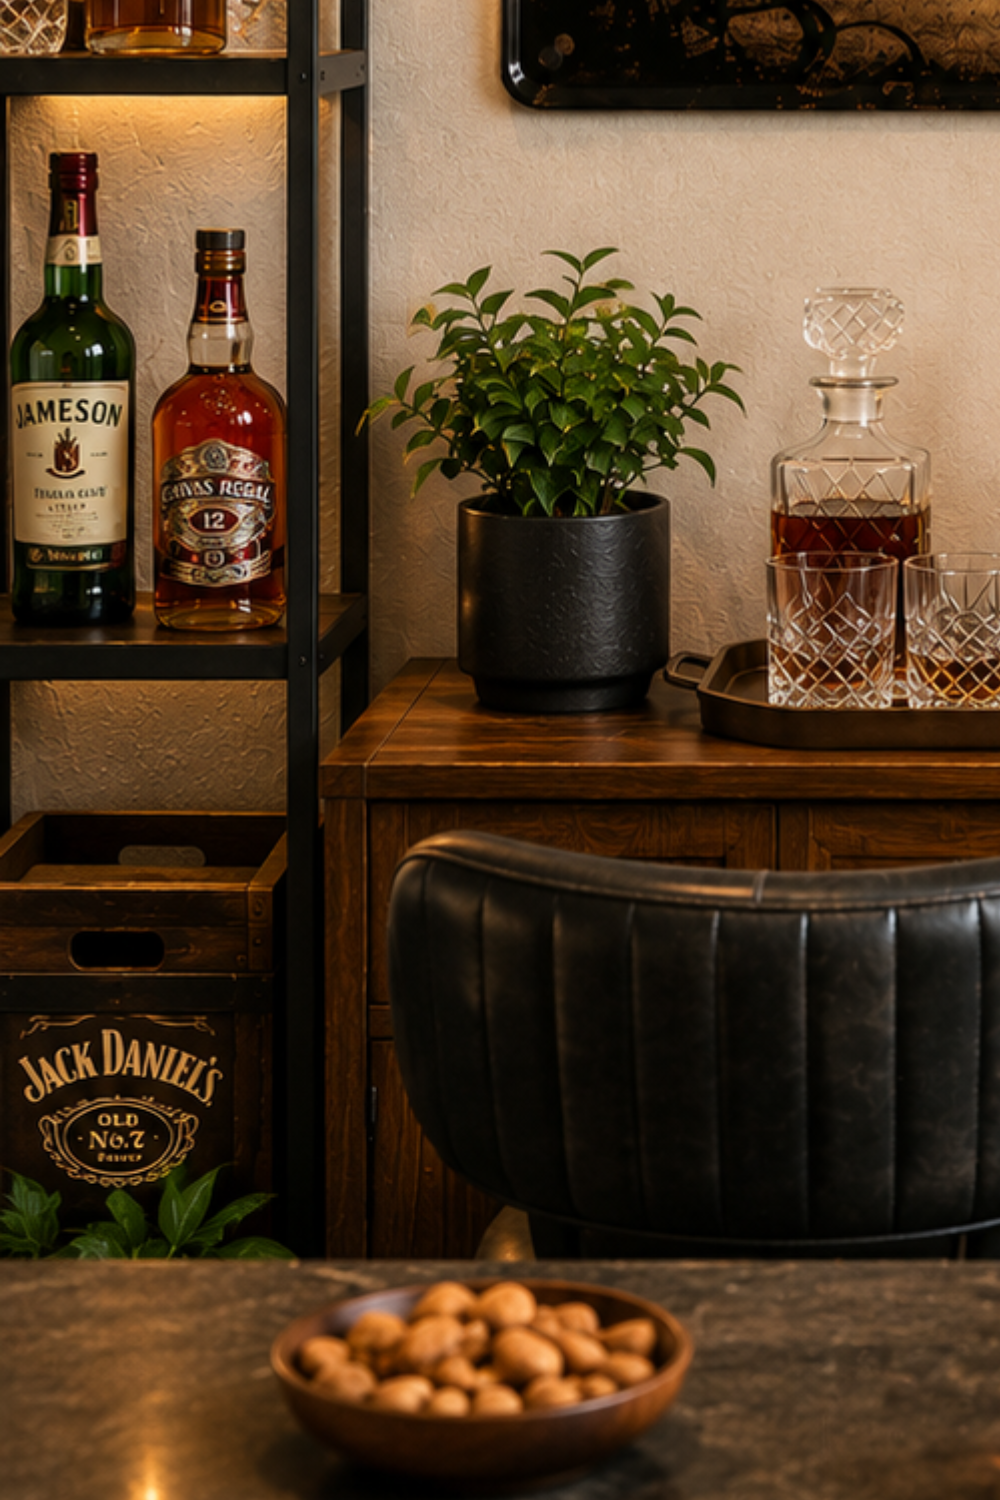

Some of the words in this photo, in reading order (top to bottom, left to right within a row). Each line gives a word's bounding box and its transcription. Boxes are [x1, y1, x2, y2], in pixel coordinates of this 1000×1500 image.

[16, 399, 122, 429] JAMESON
[203, 511, 225, 529] 12
[18, 1041, 99, 1103] JACK
[101, 1028, 224, 1107] DANIEL'S
[97, 1112, 139, 1127] OLD
